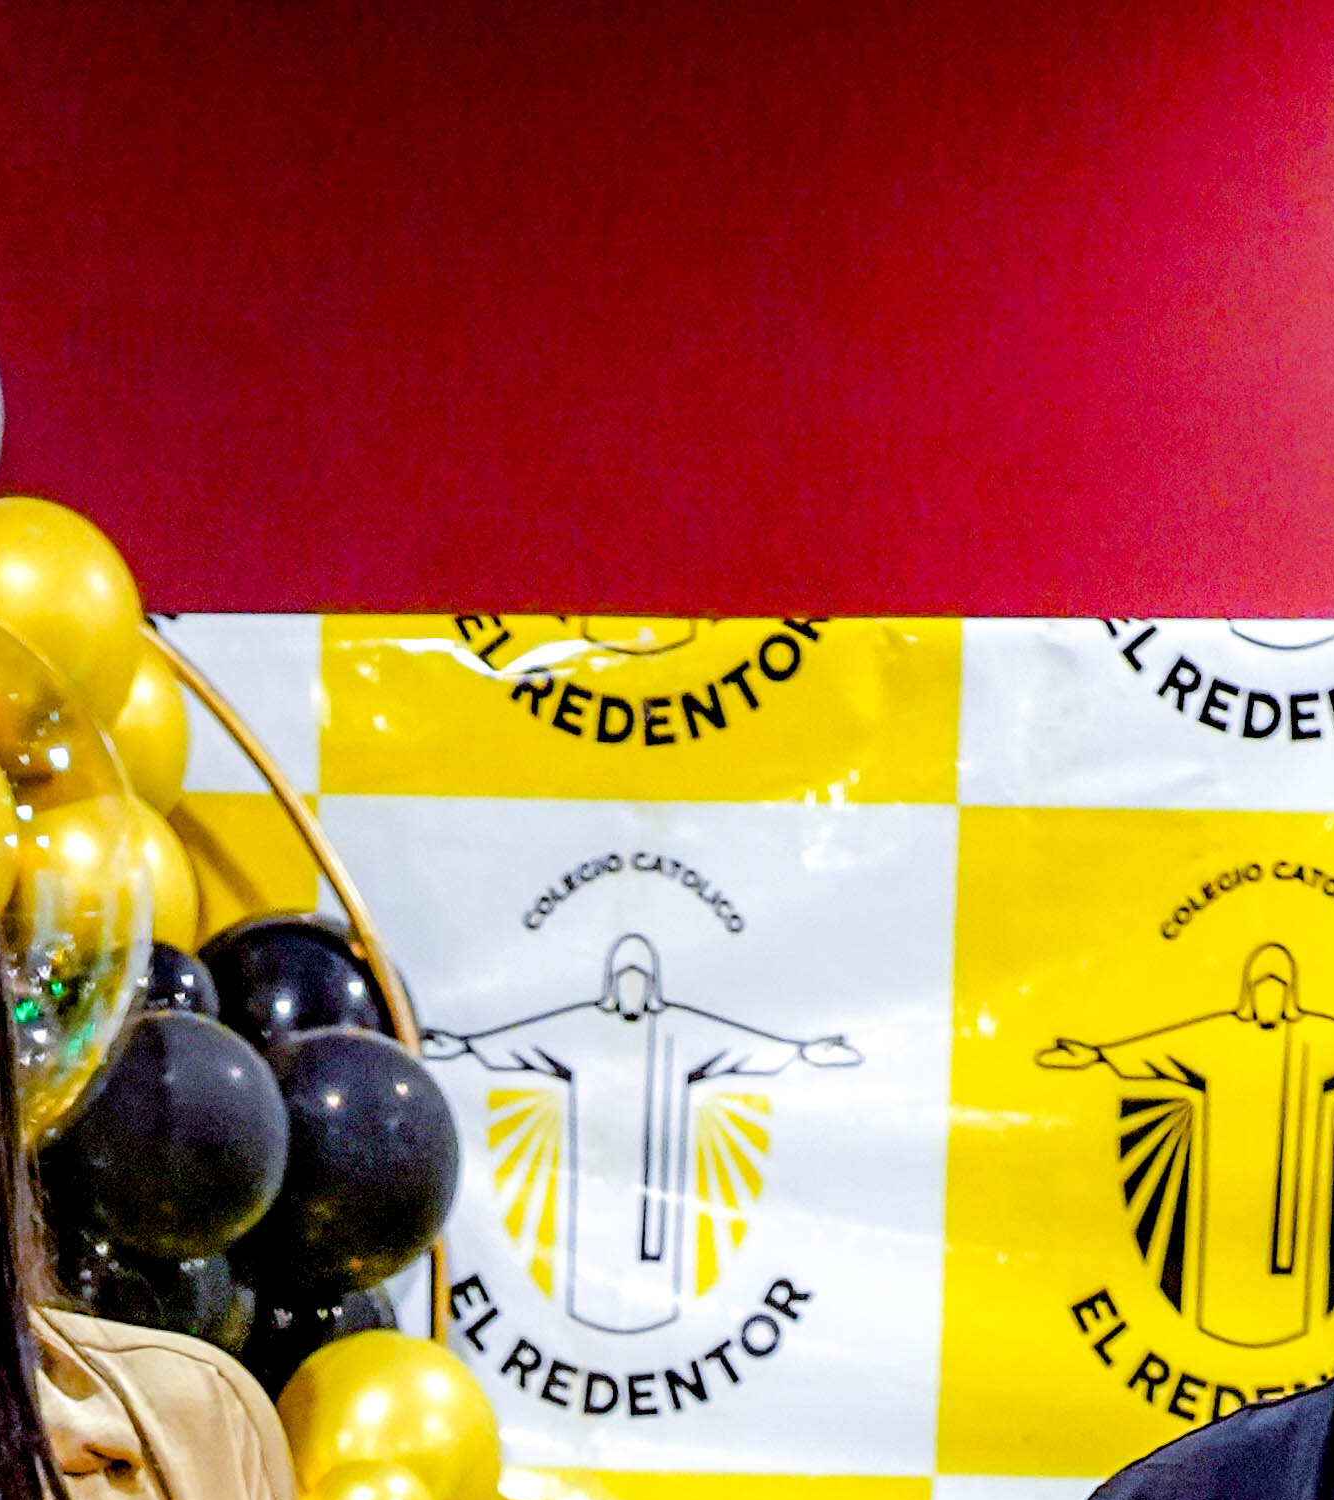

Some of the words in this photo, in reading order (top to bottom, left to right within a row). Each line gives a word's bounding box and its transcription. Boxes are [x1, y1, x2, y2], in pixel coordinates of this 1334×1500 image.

[1103, 618, 1157, 672] L
[524, 853, 624, 934] COLEGIO
[633, 852, 746, 936] CATOLICO
[1161, 863, 1263, 943] COLEGIO
[450, 1272, 492, 1355] EL
[500, 1276, 815, 1418] REDENTOR
[1071, 1288, 1128, 1367] EL
